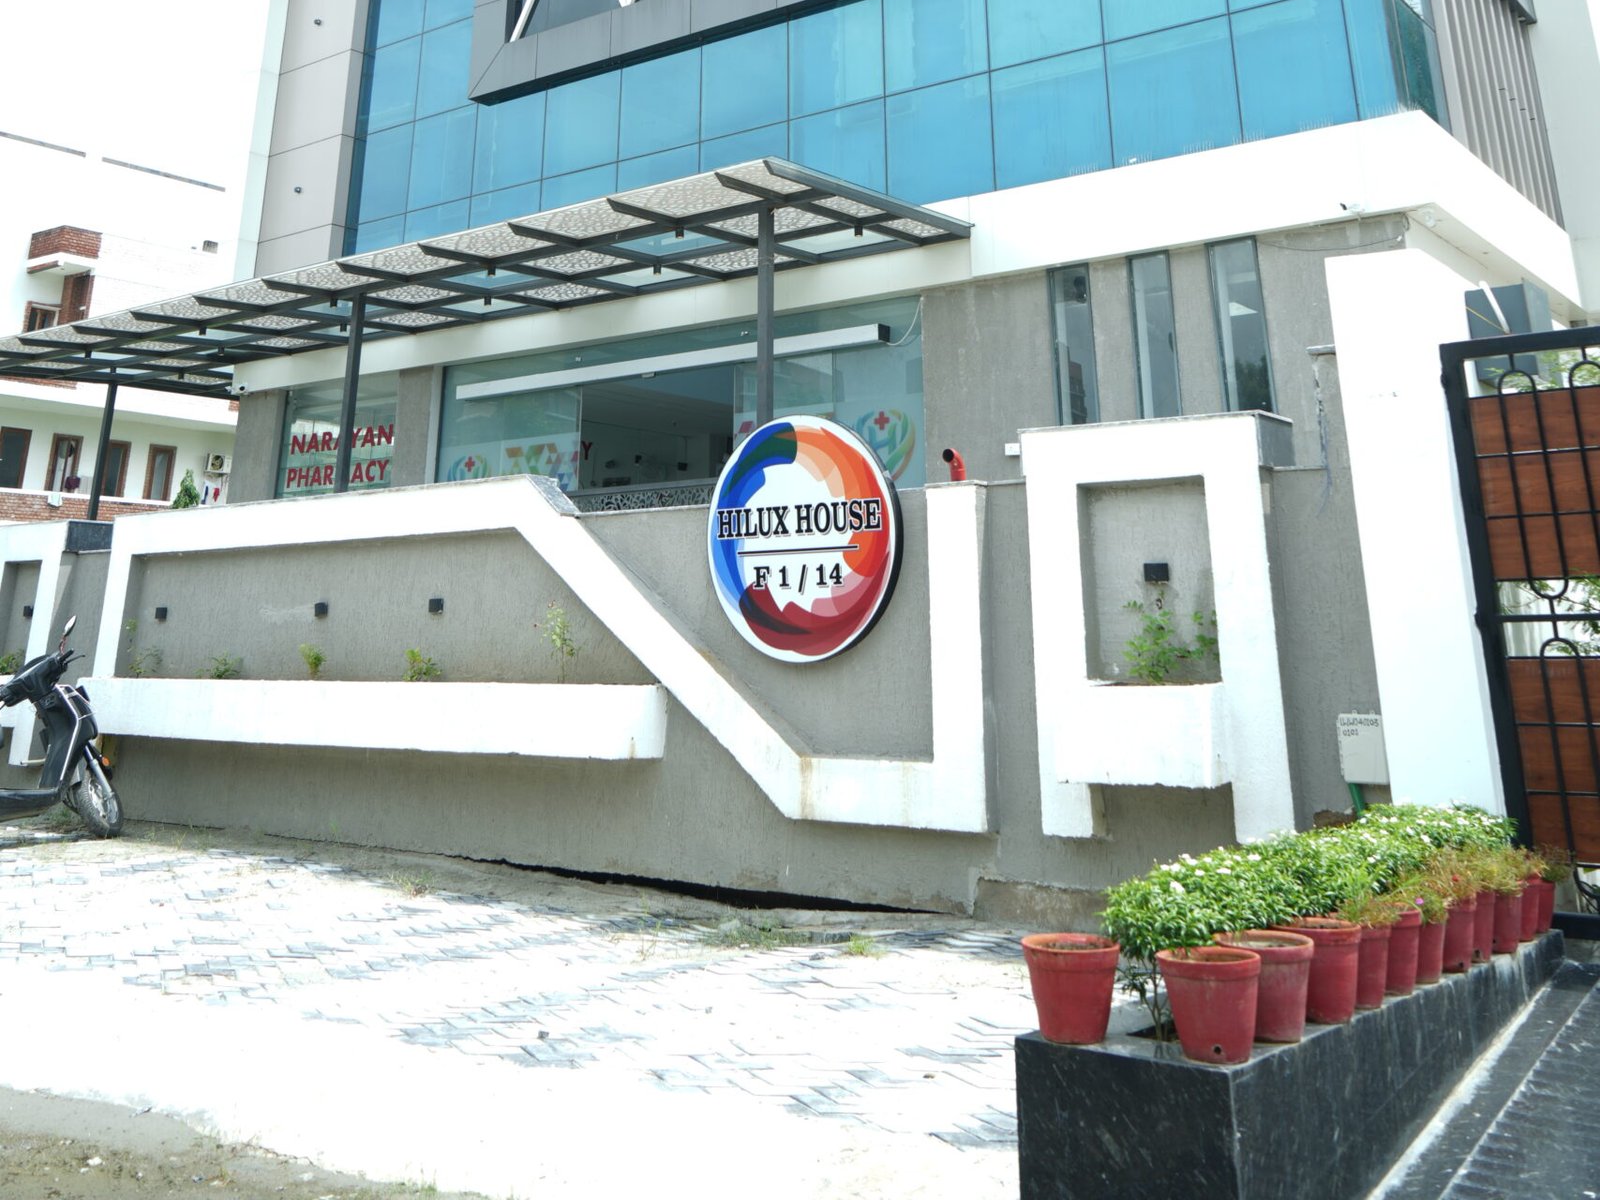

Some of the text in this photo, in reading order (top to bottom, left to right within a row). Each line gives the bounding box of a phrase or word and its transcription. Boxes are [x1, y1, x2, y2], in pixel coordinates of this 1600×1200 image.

[286, 459, 389, 488] PHARACY
[717, 499, 881, 538] HILUX HOUSE
